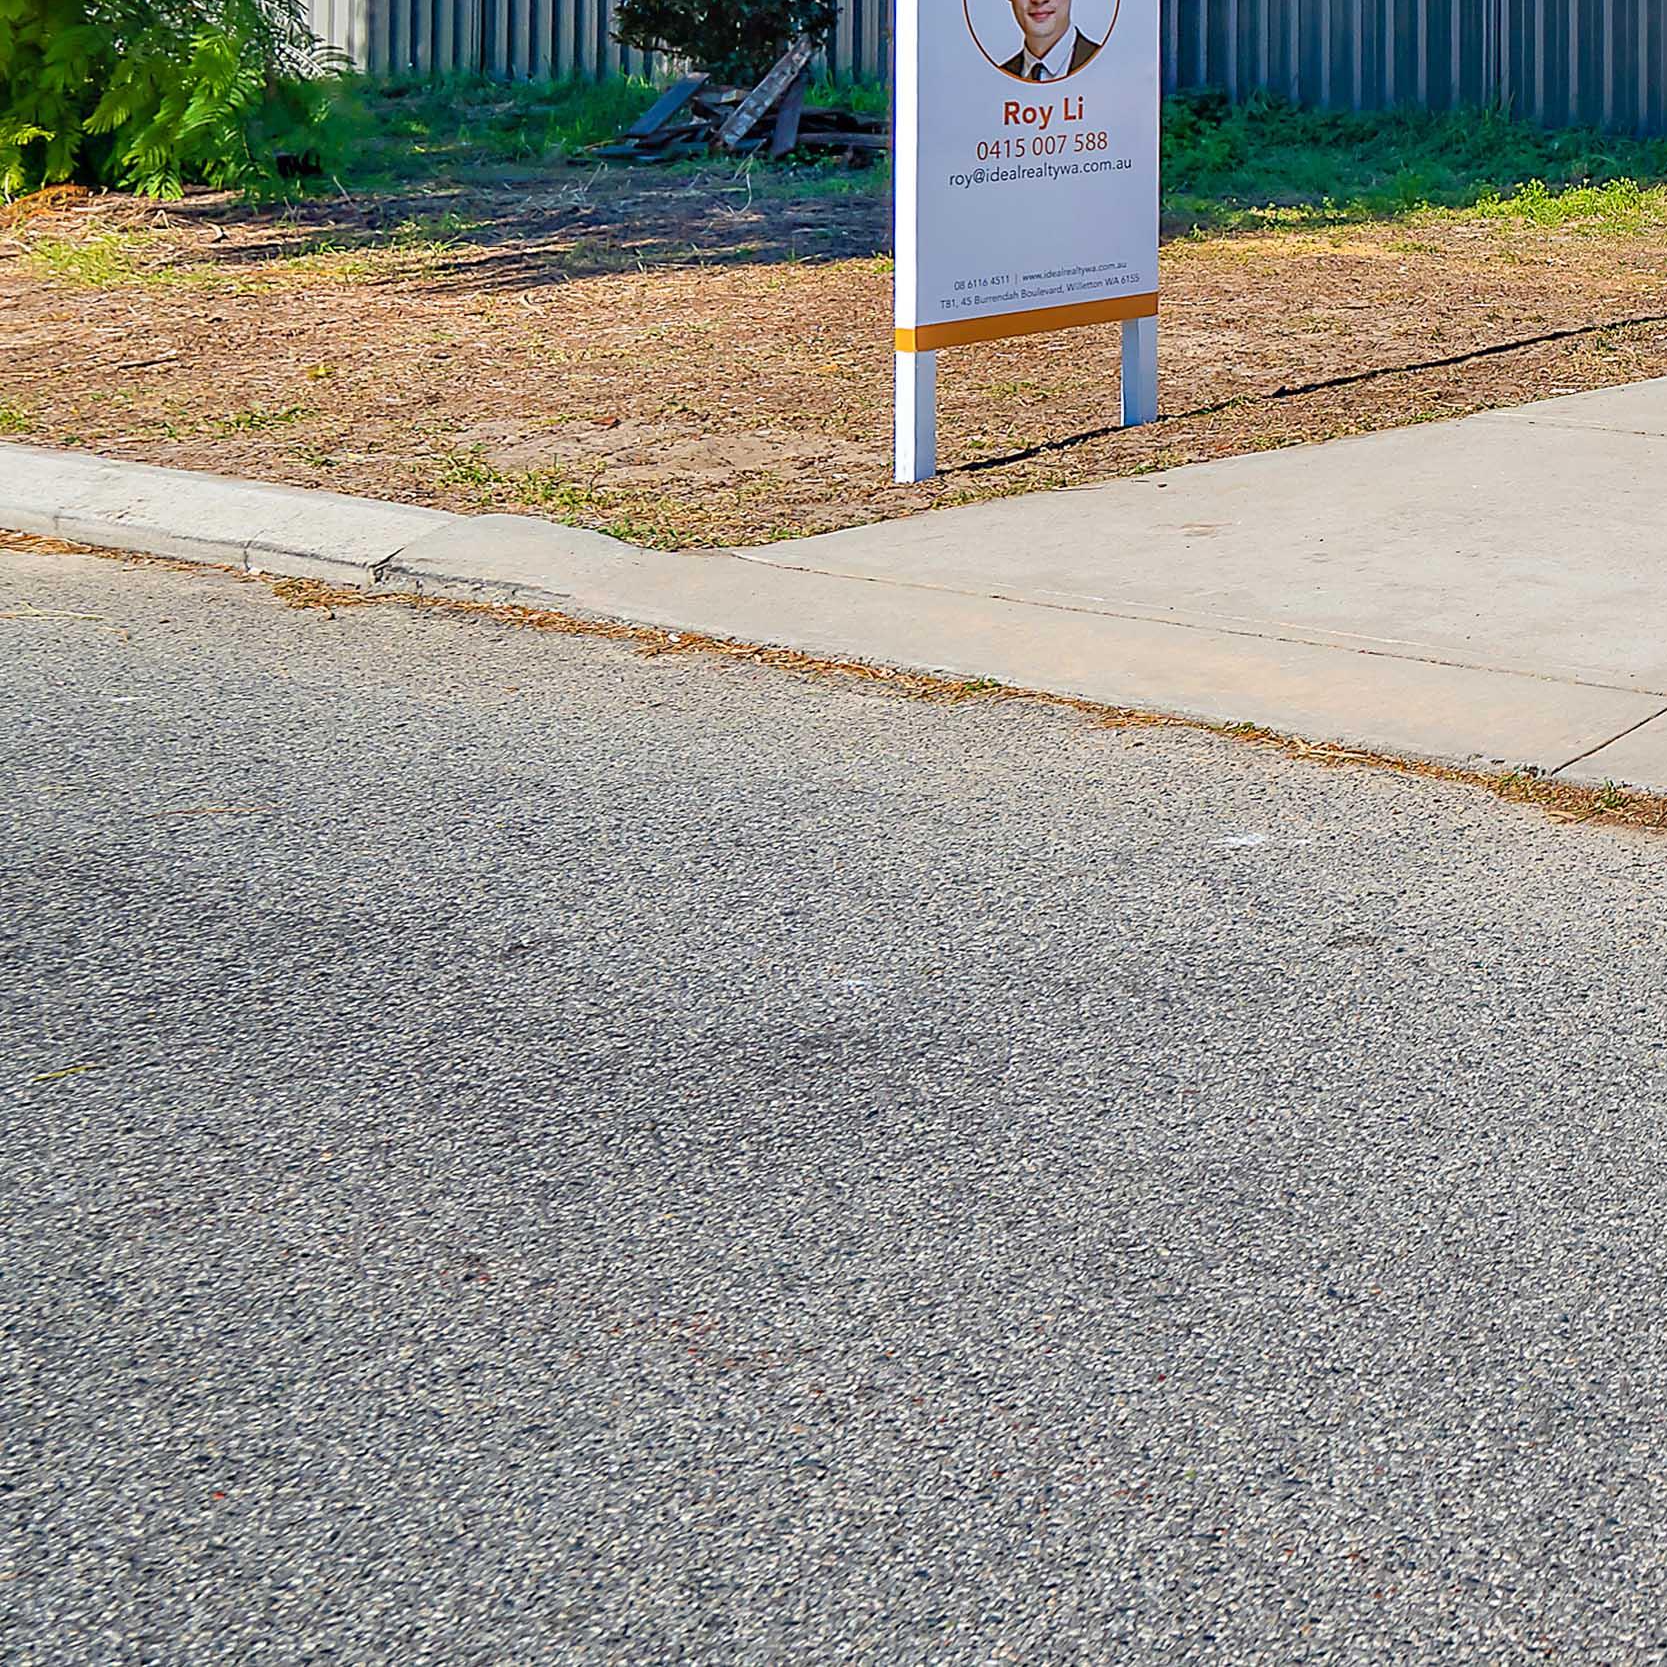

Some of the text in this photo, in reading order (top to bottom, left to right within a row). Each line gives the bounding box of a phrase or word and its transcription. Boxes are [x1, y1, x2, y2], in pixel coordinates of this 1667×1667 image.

[1004, 96, 1083, 130] Roy Li
[976, 131, 1108, 161] 0415 007 588
[949, 158, 1132, 189] roy@idealrealtywa.com.au
[954, 281, 965, 291] 08
[967, 278, 988, 289] 6116
[990, 275, 1009, 285] 4511
[1104, 276, 1119, 286] WA
